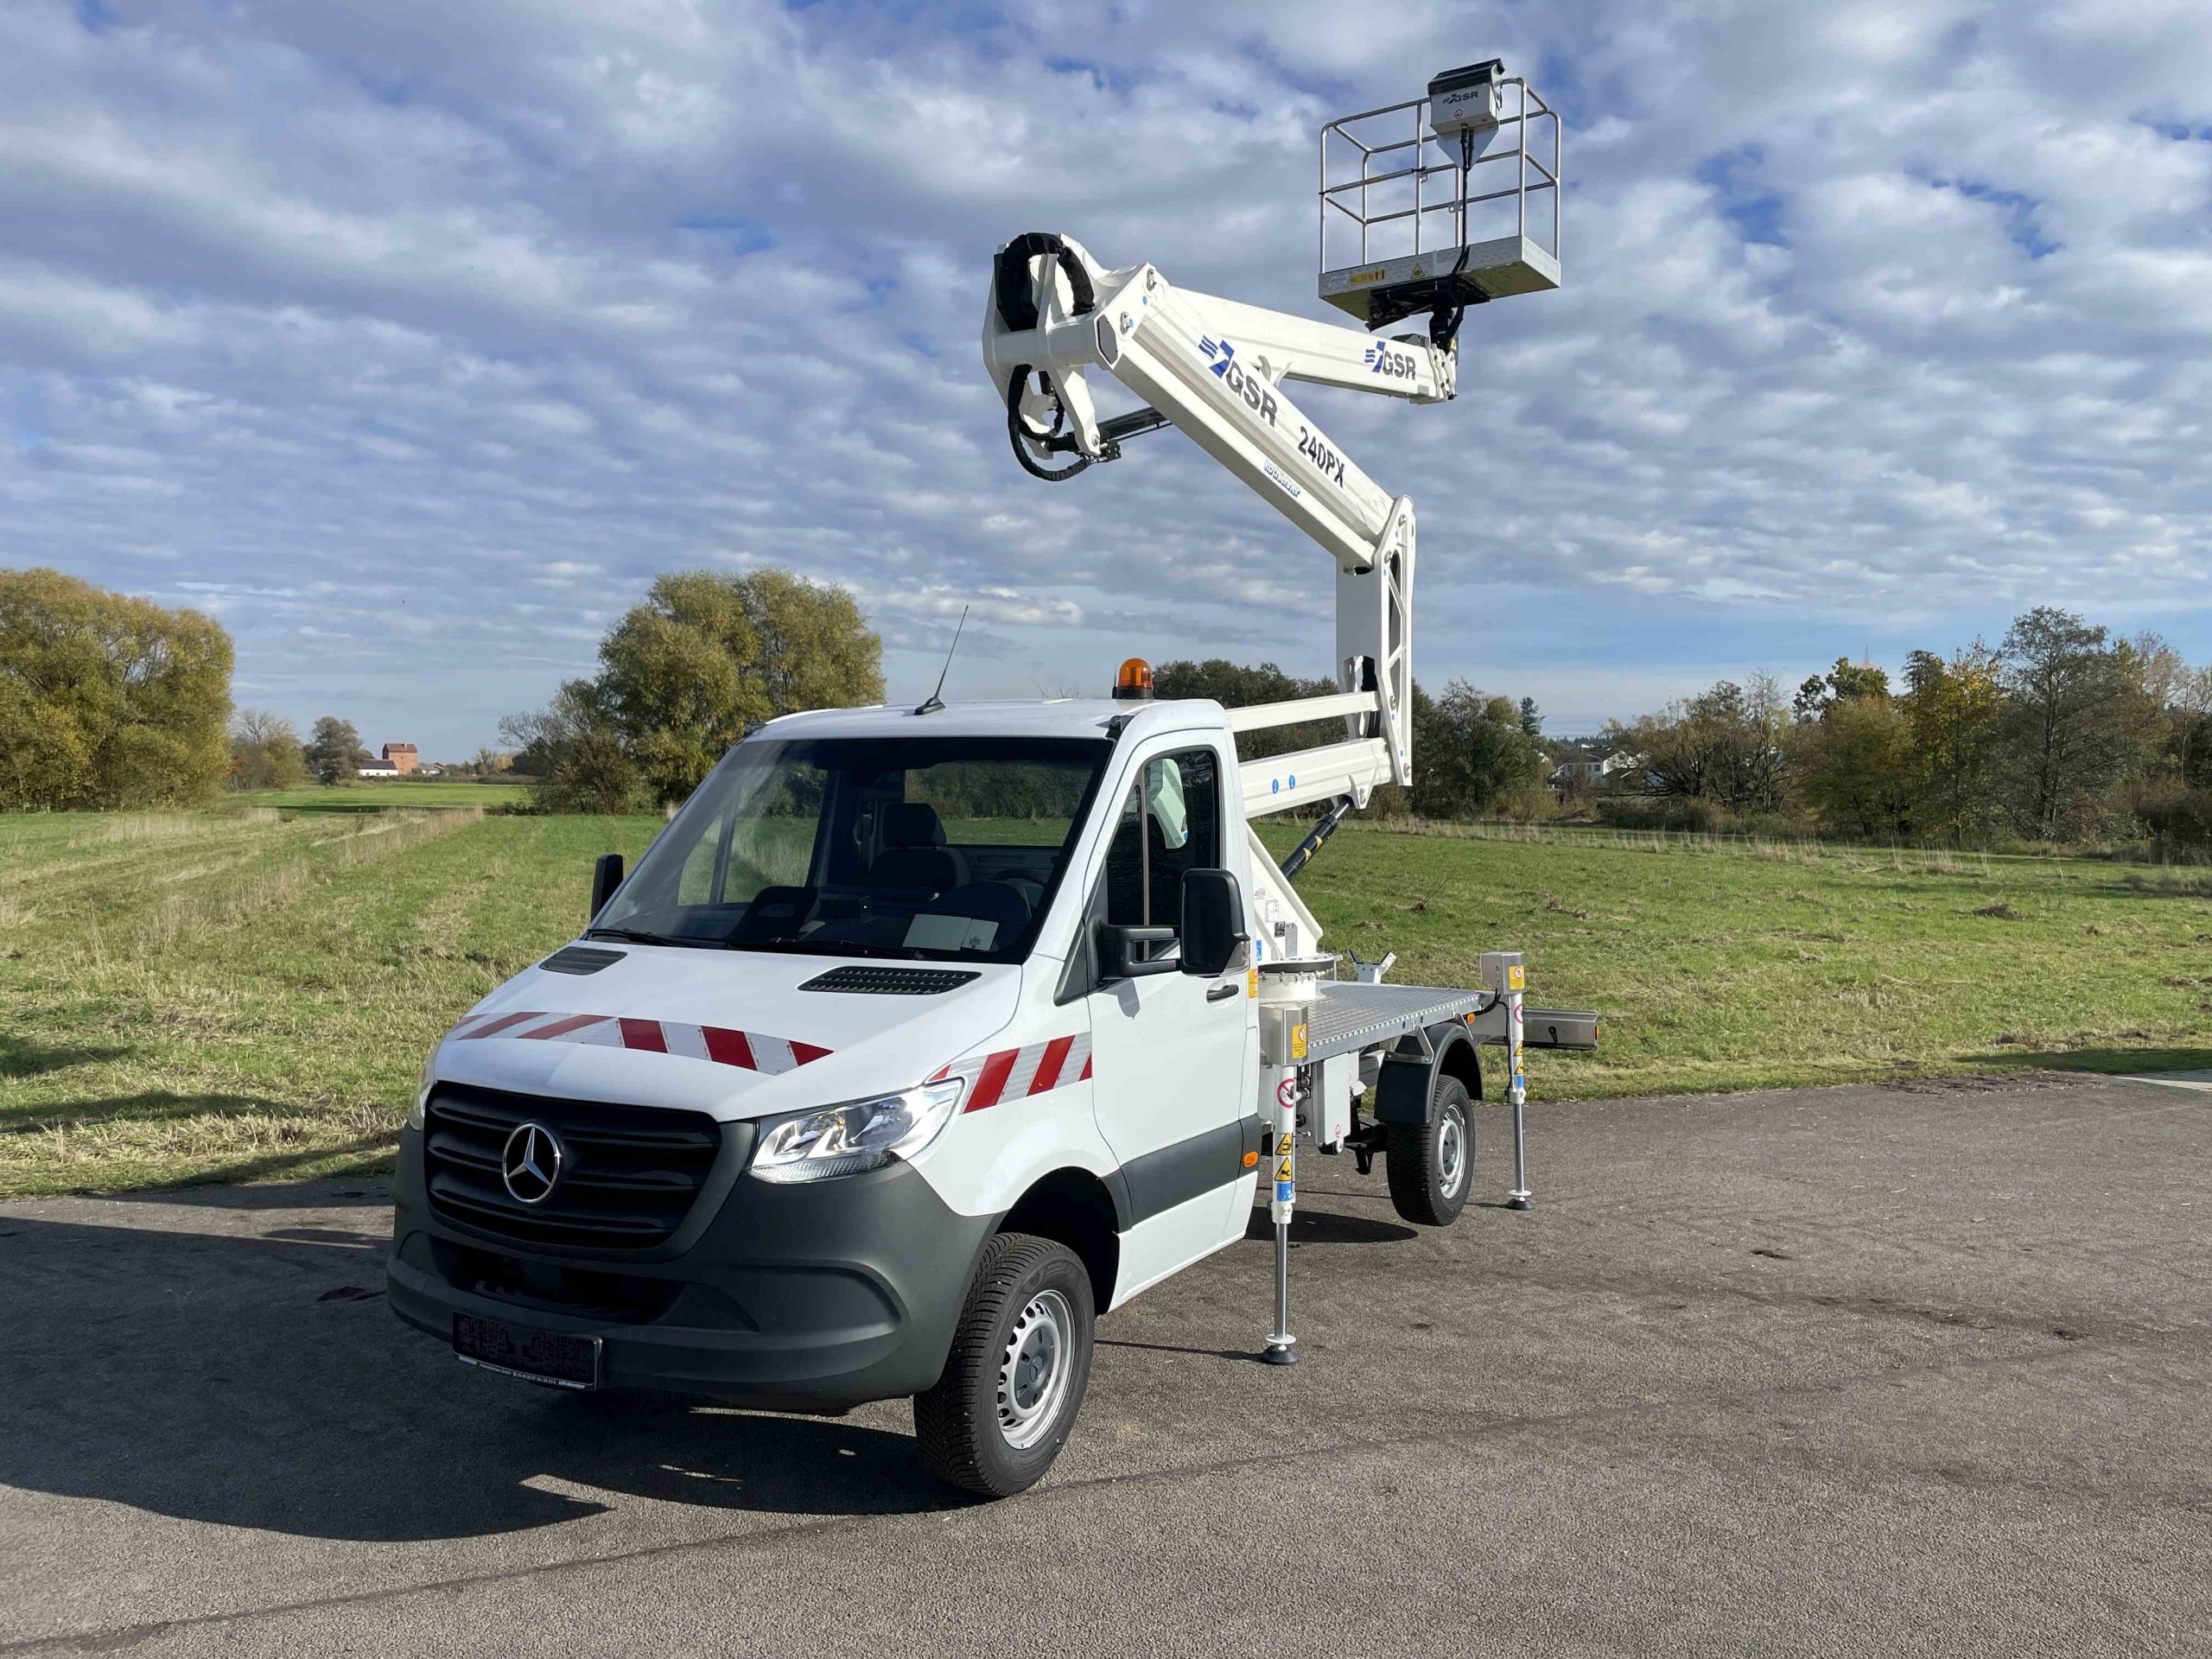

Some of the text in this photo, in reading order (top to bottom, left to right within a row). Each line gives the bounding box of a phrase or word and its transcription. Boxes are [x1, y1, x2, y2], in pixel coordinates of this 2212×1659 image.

[1454, 91, 1478, 102] GSR
[1382, 350, 1416, 380] GSR
[1225, 359, 1277, 428] GSR
[1298, 425, 1345, 488] 240PX
